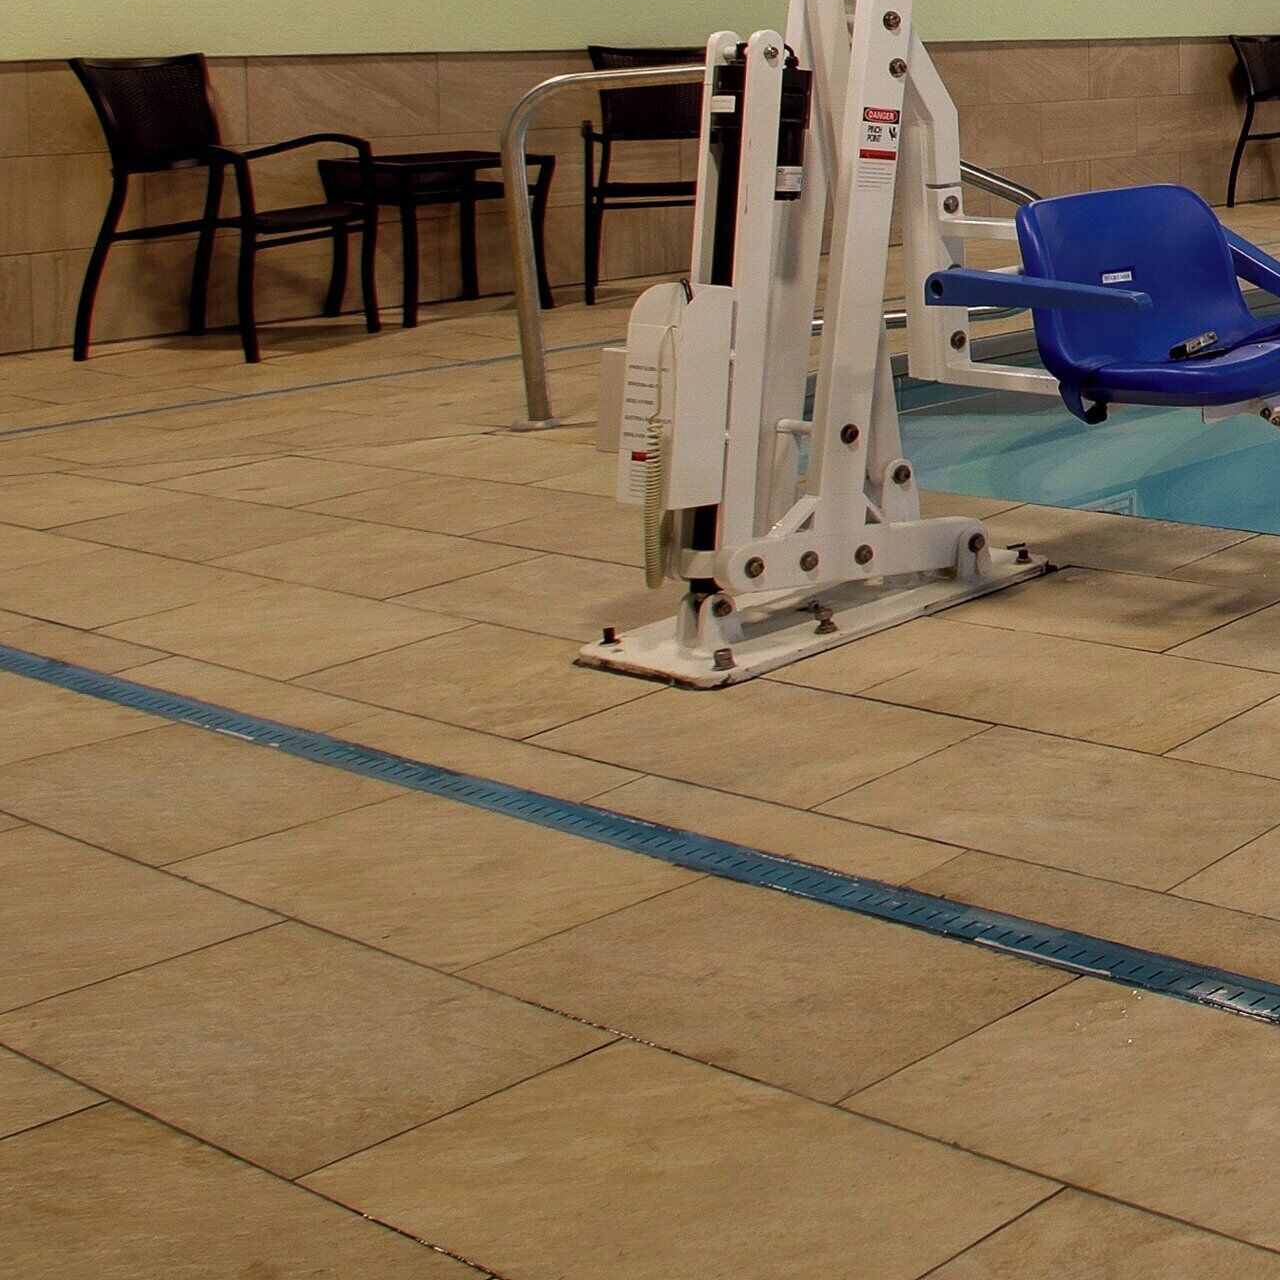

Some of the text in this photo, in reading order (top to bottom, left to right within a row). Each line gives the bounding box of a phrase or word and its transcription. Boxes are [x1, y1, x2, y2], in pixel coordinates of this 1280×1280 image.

[868, 110, 895, 120] DANGER
[867, 125, 882, 133] PINCH
[866, 134, 881, 143] POINT
